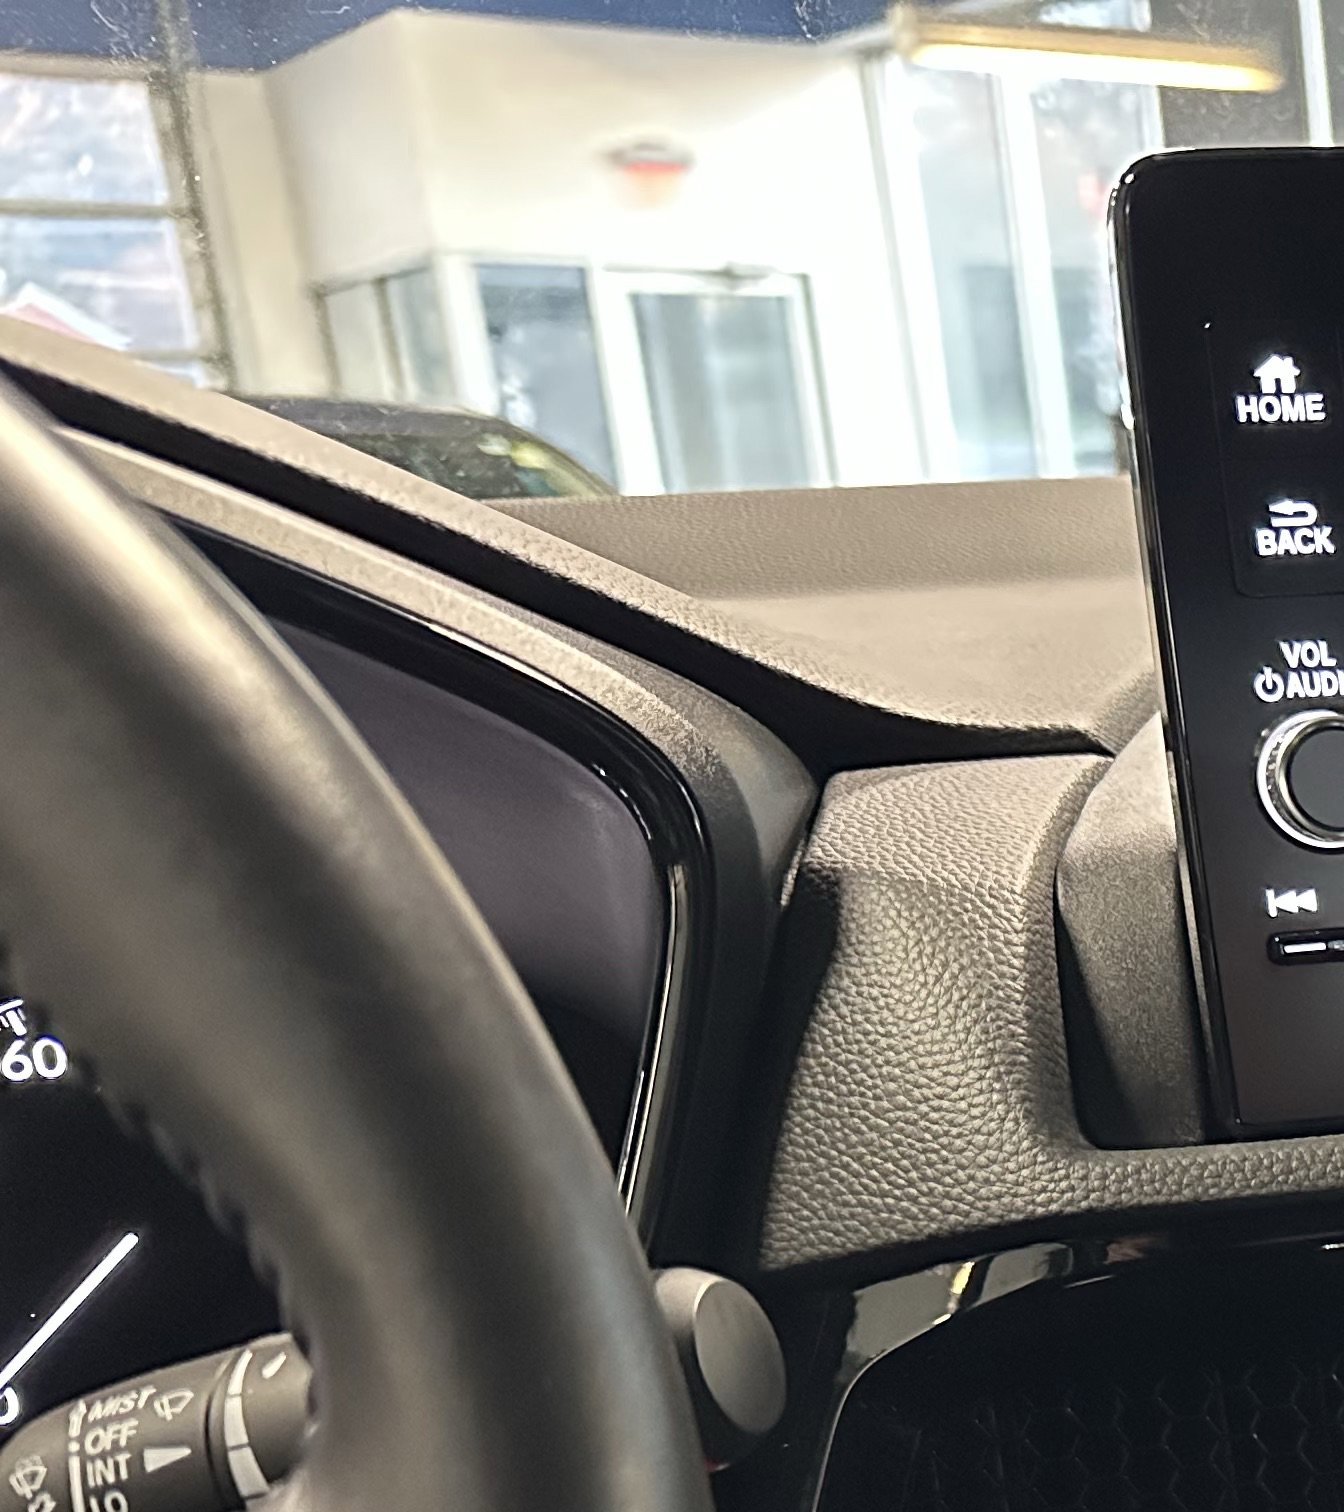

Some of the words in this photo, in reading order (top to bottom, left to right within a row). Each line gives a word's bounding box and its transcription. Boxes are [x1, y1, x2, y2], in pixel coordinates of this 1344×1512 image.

[1236, 392, 1326, 424] HOME
[1255, 524, 1335, 556] BACK
[1279, 639, 1340, 672] VOL
[1, 1036, 69, 1081] 60
[88, 1385, 157, 1421] MIST
[84, 1418, 139, 1455] OFF
[86, 1452, 132, 1488] INT
